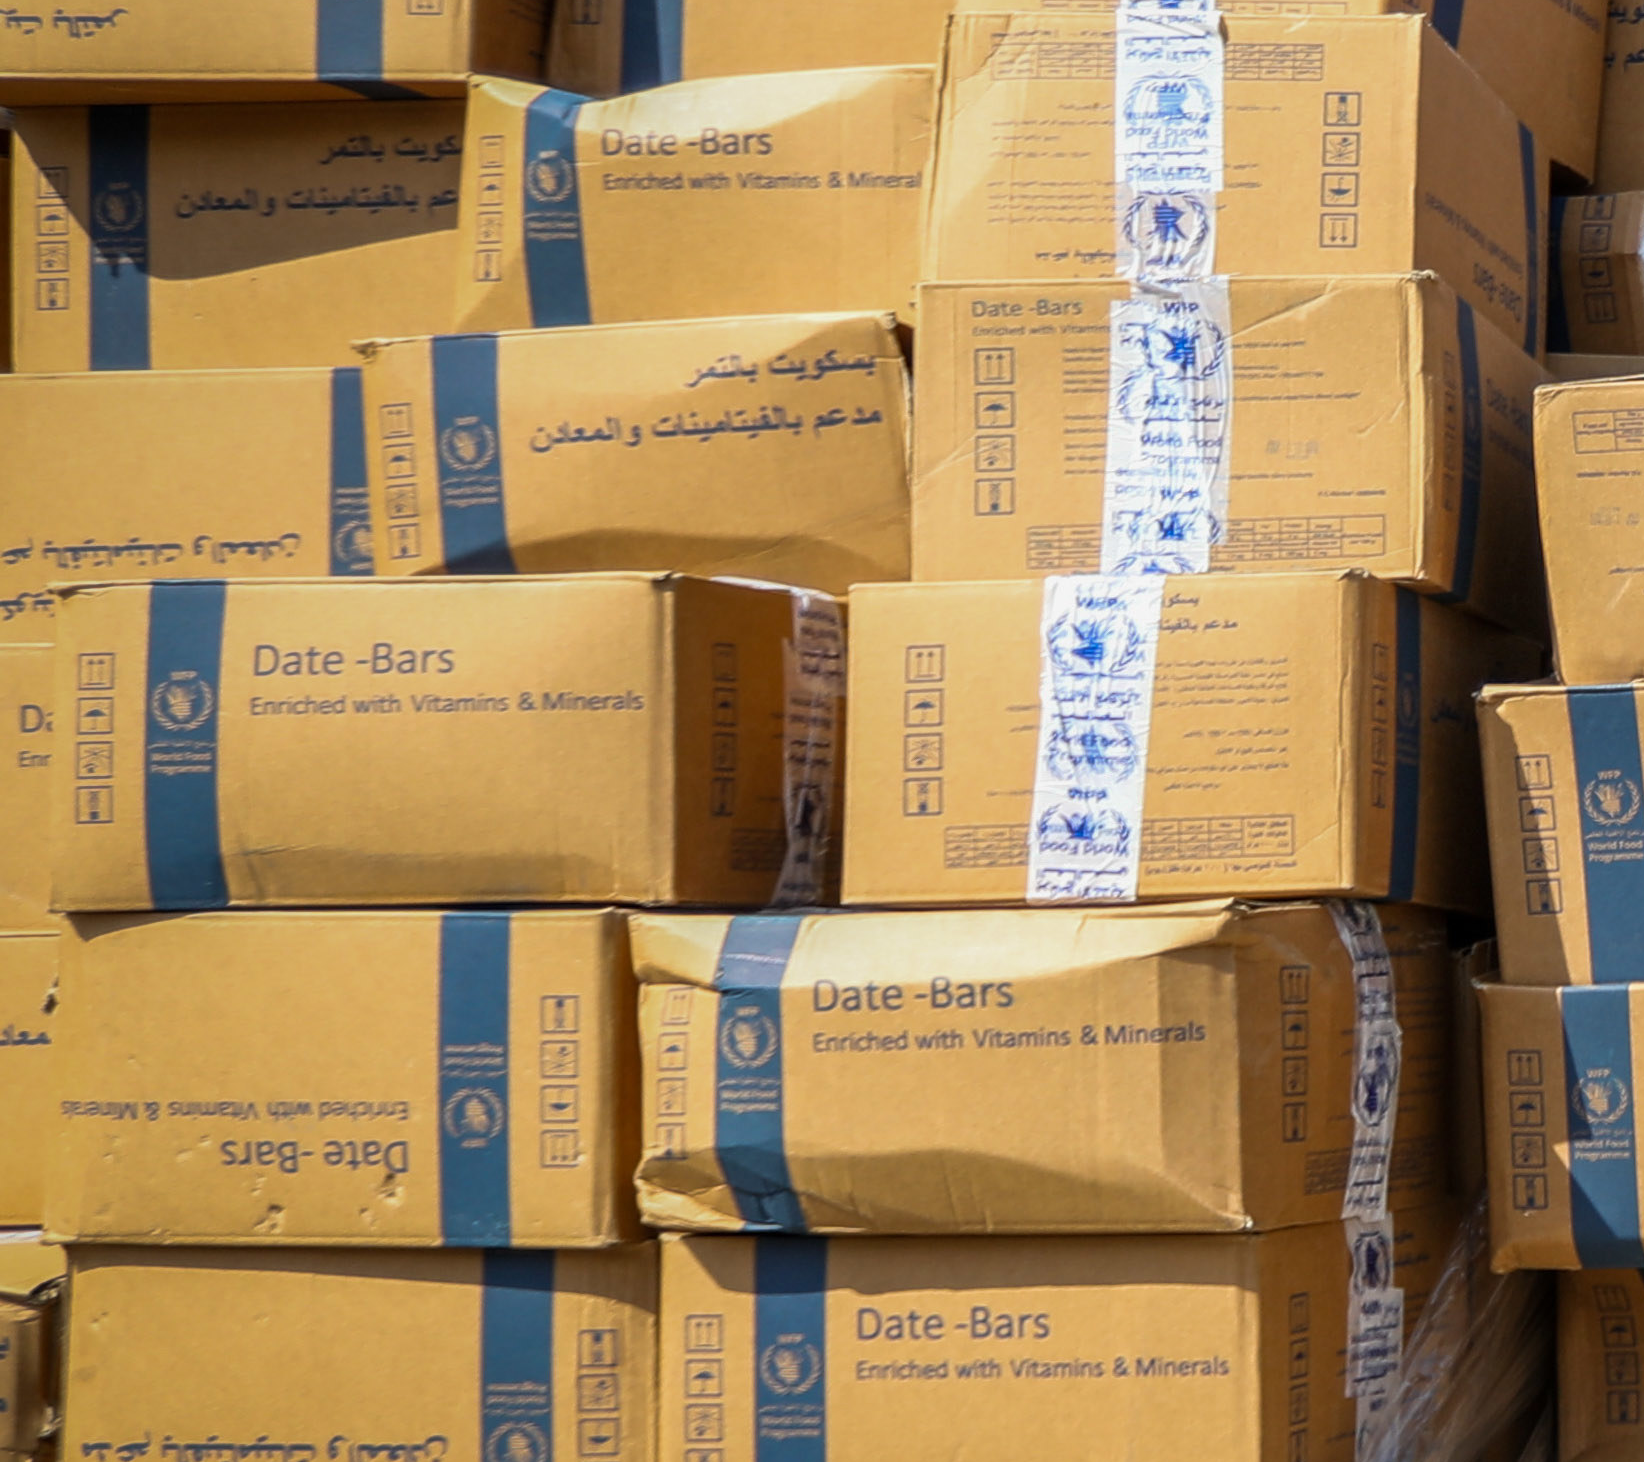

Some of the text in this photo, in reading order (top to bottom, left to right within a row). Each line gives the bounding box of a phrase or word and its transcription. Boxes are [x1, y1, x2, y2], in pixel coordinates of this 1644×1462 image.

[253, 644, 345, 677] Date
[812, 980, 904, 1013] Date
[323, 1140, 409, 1173] Date
[856, 1305, 1050, 1341] Date -Bars
[855, 1359, 950, 1381] Enriched
[954, 1358, 1002, 1379] with
[1009, 1358, 1106, 1379] Vitamins
[1134, 1355, 1230, 1377] Minerals
